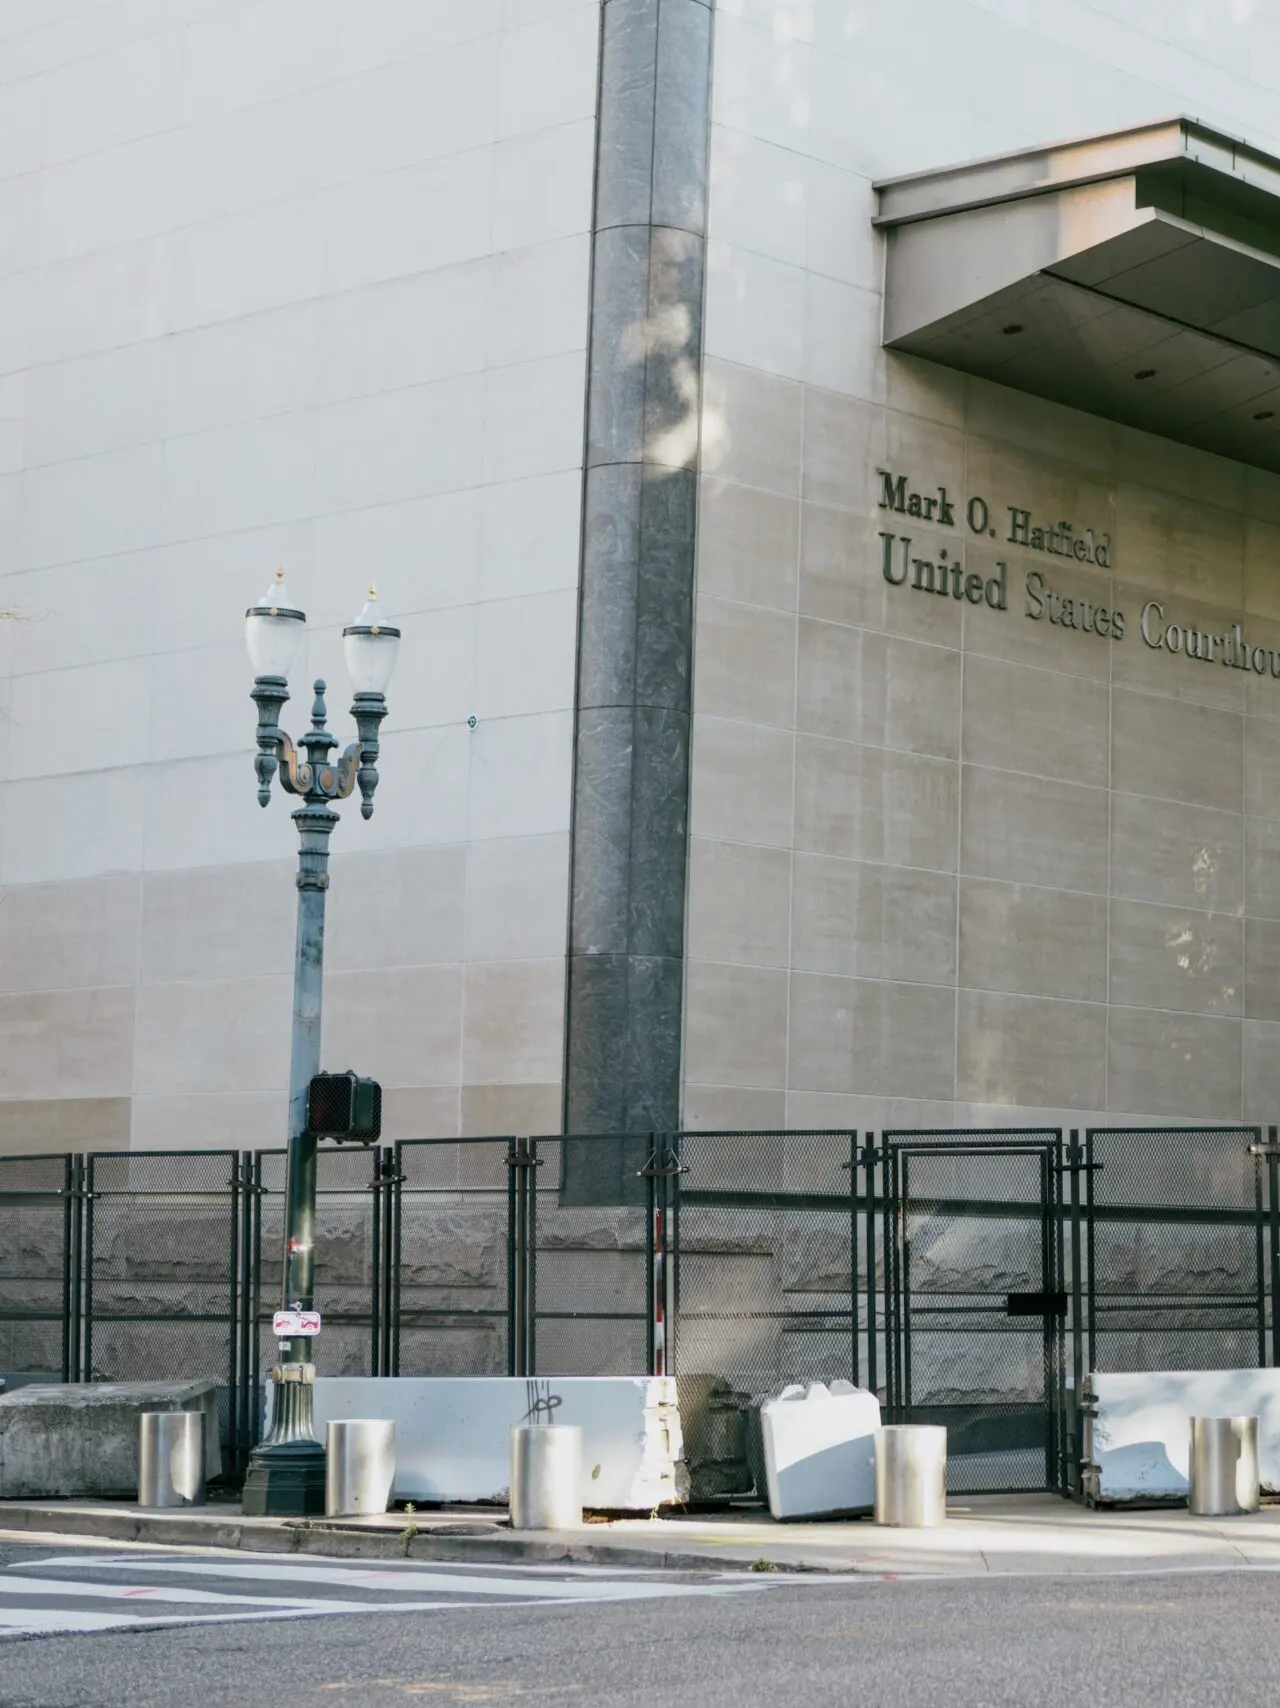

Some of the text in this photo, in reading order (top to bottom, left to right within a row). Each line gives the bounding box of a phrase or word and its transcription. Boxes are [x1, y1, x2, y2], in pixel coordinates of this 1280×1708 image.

[876, 468, 1112, 568] Mark O. Hatfield
[878, 532, 1007, 611] United
[1025, 571, 1125, 640] States
